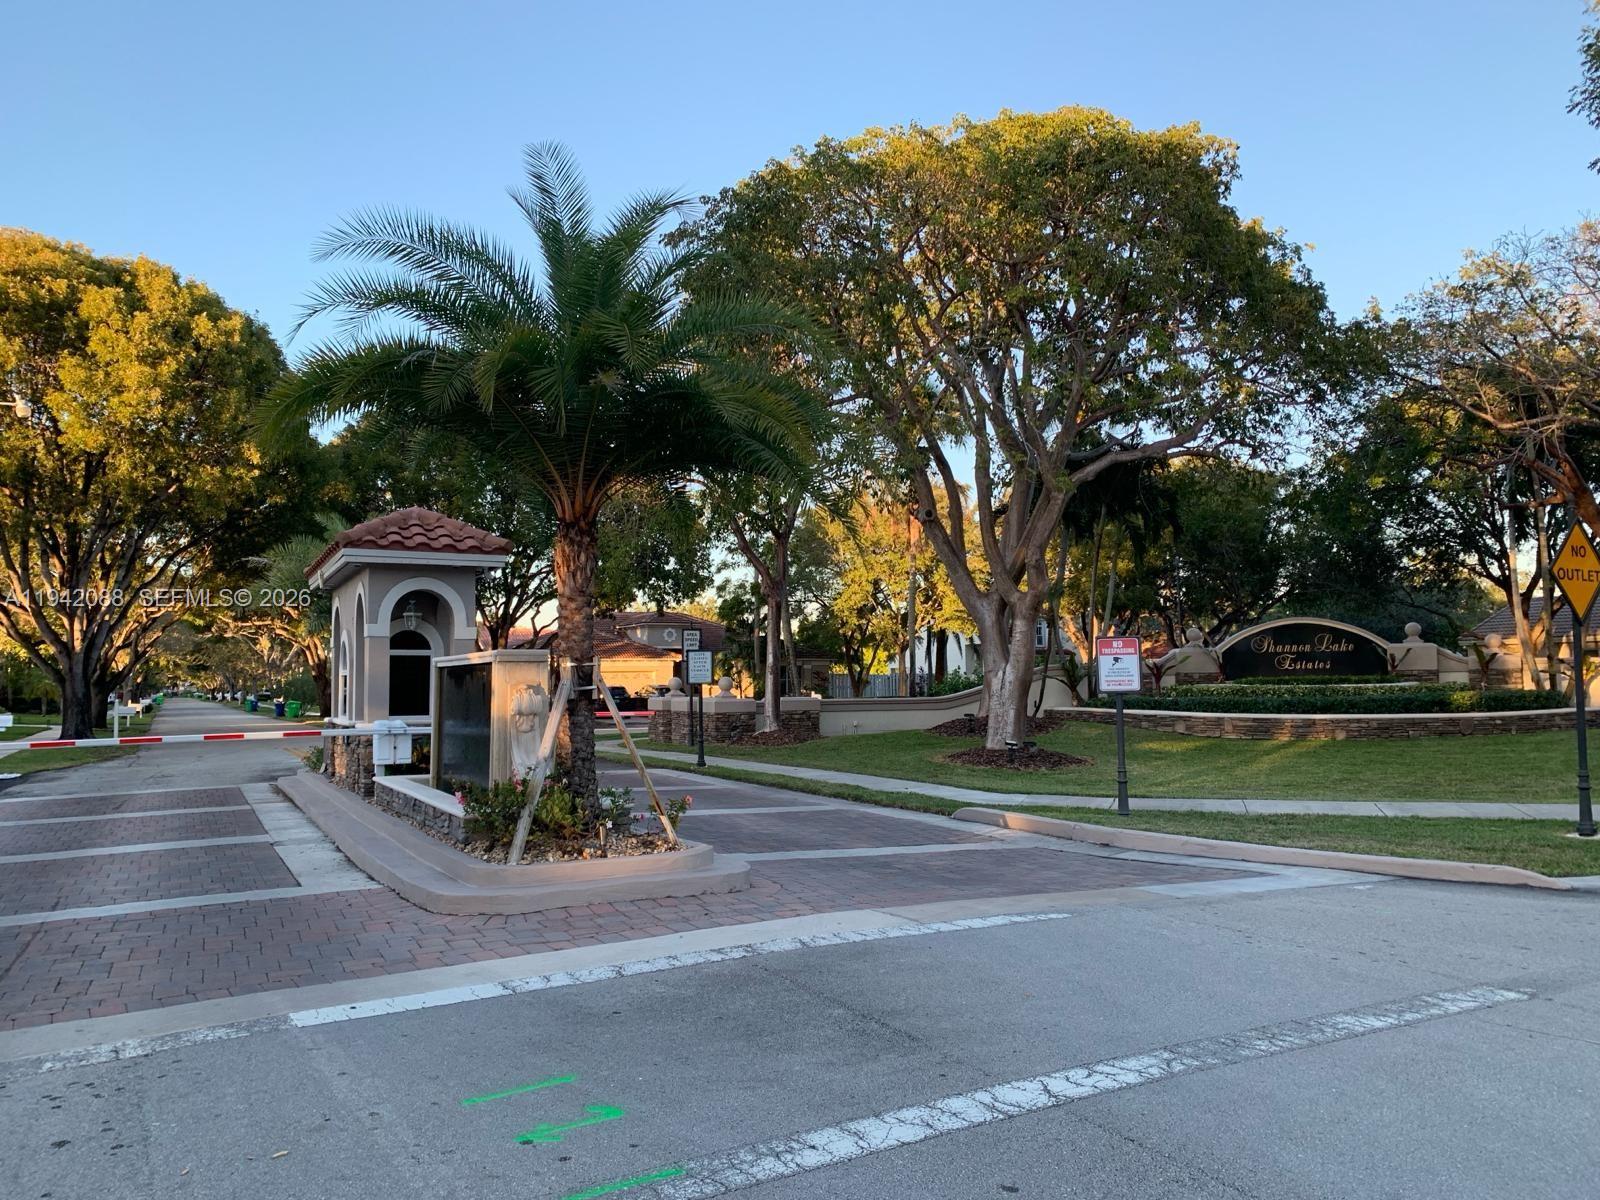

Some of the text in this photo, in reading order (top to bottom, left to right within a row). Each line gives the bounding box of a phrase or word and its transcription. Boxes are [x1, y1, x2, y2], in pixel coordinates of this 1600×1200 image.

[1571, 545, 1587, 558] NO
[1557, 568, 1600, 582] OUTLET
[1250, 633, 1354, 654] Shannon Lake
[1274, 654, 1331, 670] Estates
